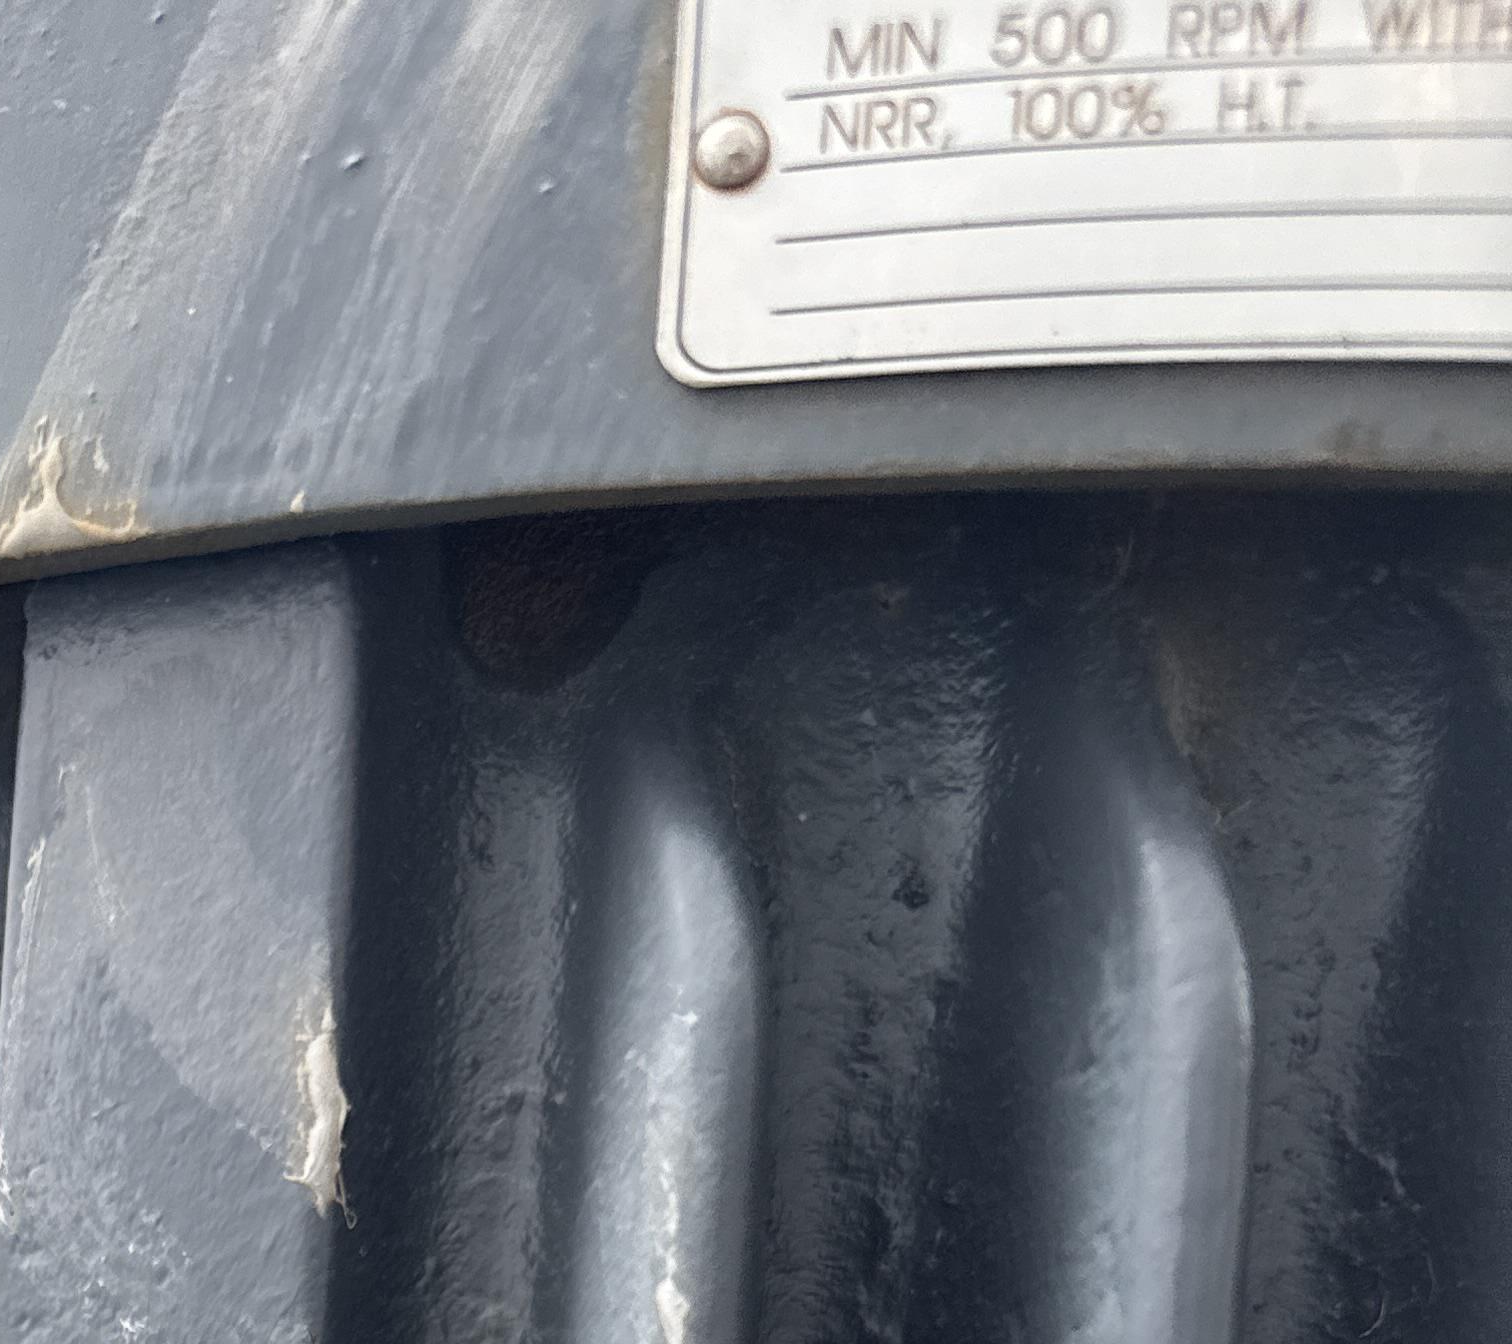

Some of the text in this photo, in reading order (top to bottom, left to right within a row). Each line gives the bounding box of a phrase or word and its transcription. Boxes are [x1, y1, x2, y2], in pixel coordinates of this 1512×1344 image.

[824, 19, 942, 79] MIN
[989, 5, 1117, 70] 500
[1165, 0, 1309, 59] RPM
[1009, 82, 1167, 140] 100%
[1216, 79, 1316, 134] H.T.
